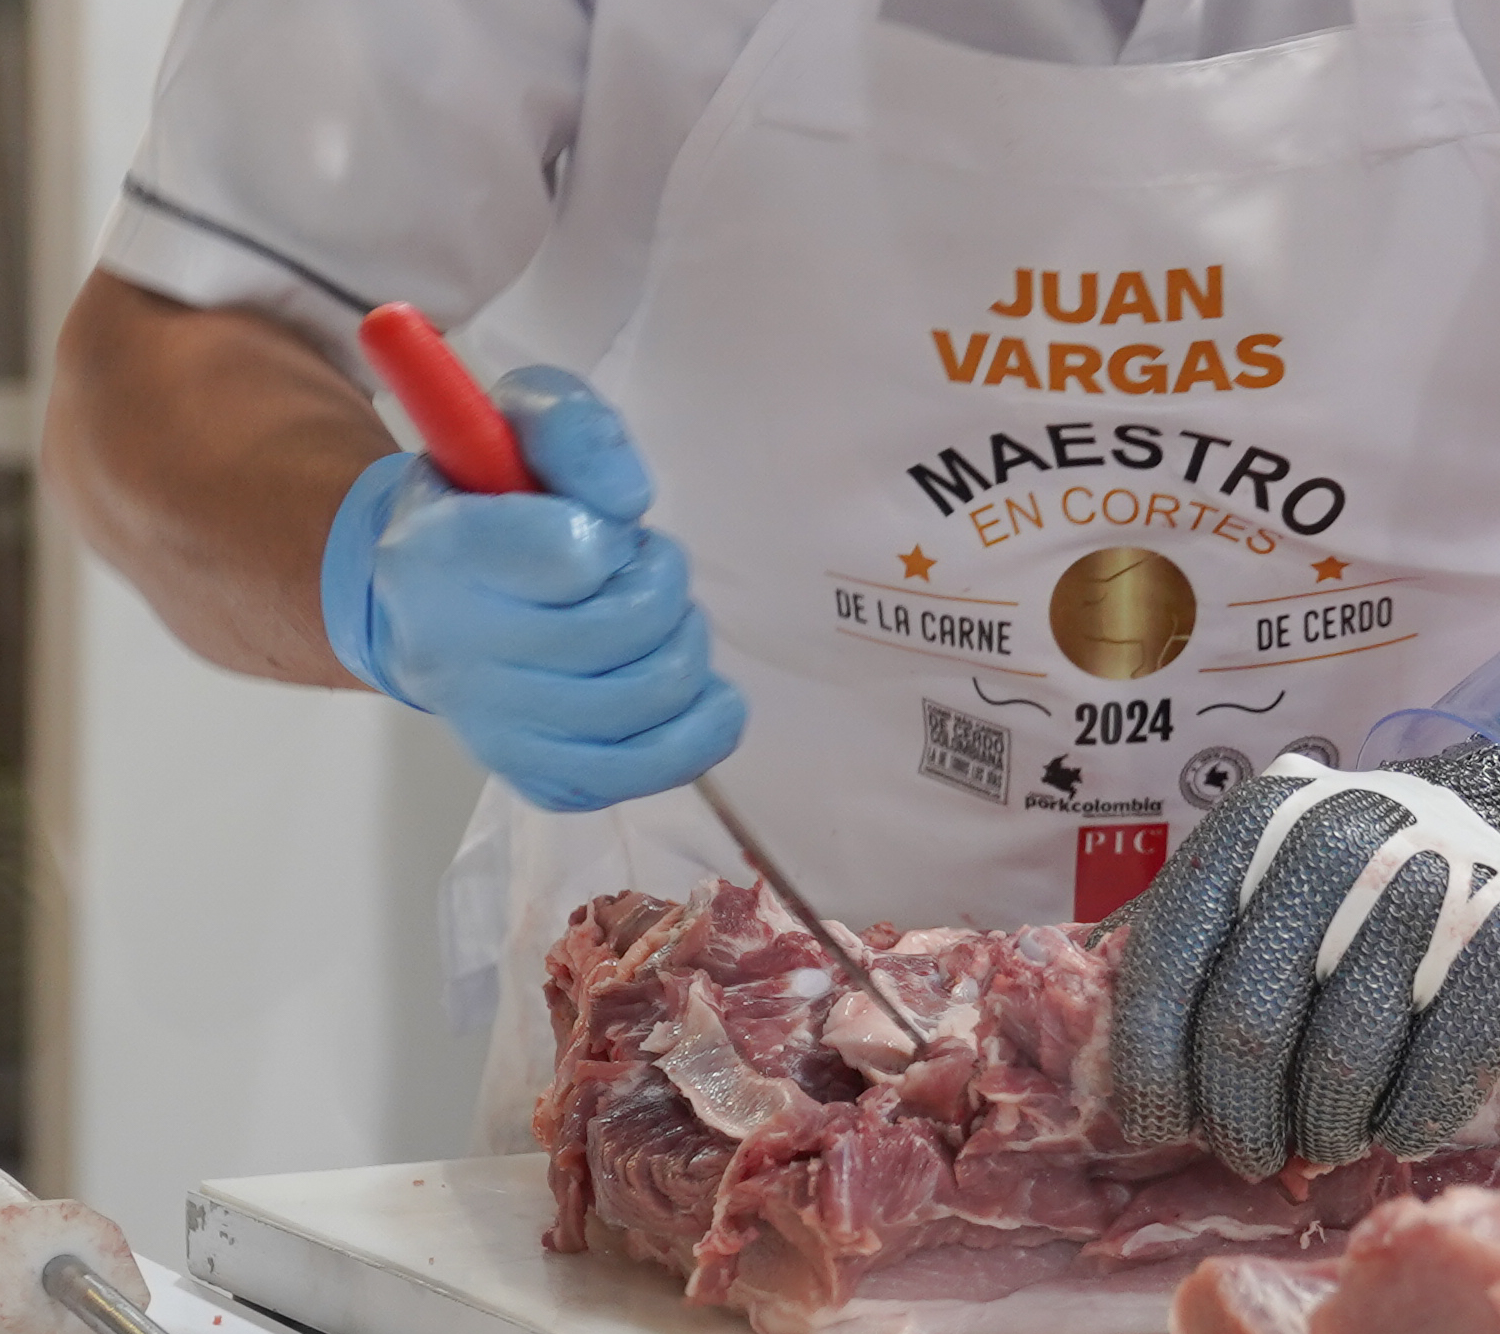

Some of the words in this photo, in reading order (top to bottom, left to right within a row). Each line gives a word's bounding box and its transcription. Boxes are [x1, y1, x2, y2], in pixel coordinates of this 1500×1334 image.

[987, 265, 1224, 325] JUAN
[931, 328, 1286, 395] VARGAS
[907, 422, 1346, 536] MAESTRO
[969, 492, 1044, 547] EN
[1061, 486, 1283, 554] CORTES
[835, 587, 868, 624] DE
[877, 600, 910, 636] LA
[921, 611, 1012, 655] CARNE
[1257, 614, 1291, 652] DE
[1303, 596, 1393, 643] CERDO
[1074, 698, 1174, 746] 2024
[1025, 795, 1162, 813] porkcolombia
[1084, 830, 1155, 854] PIC
